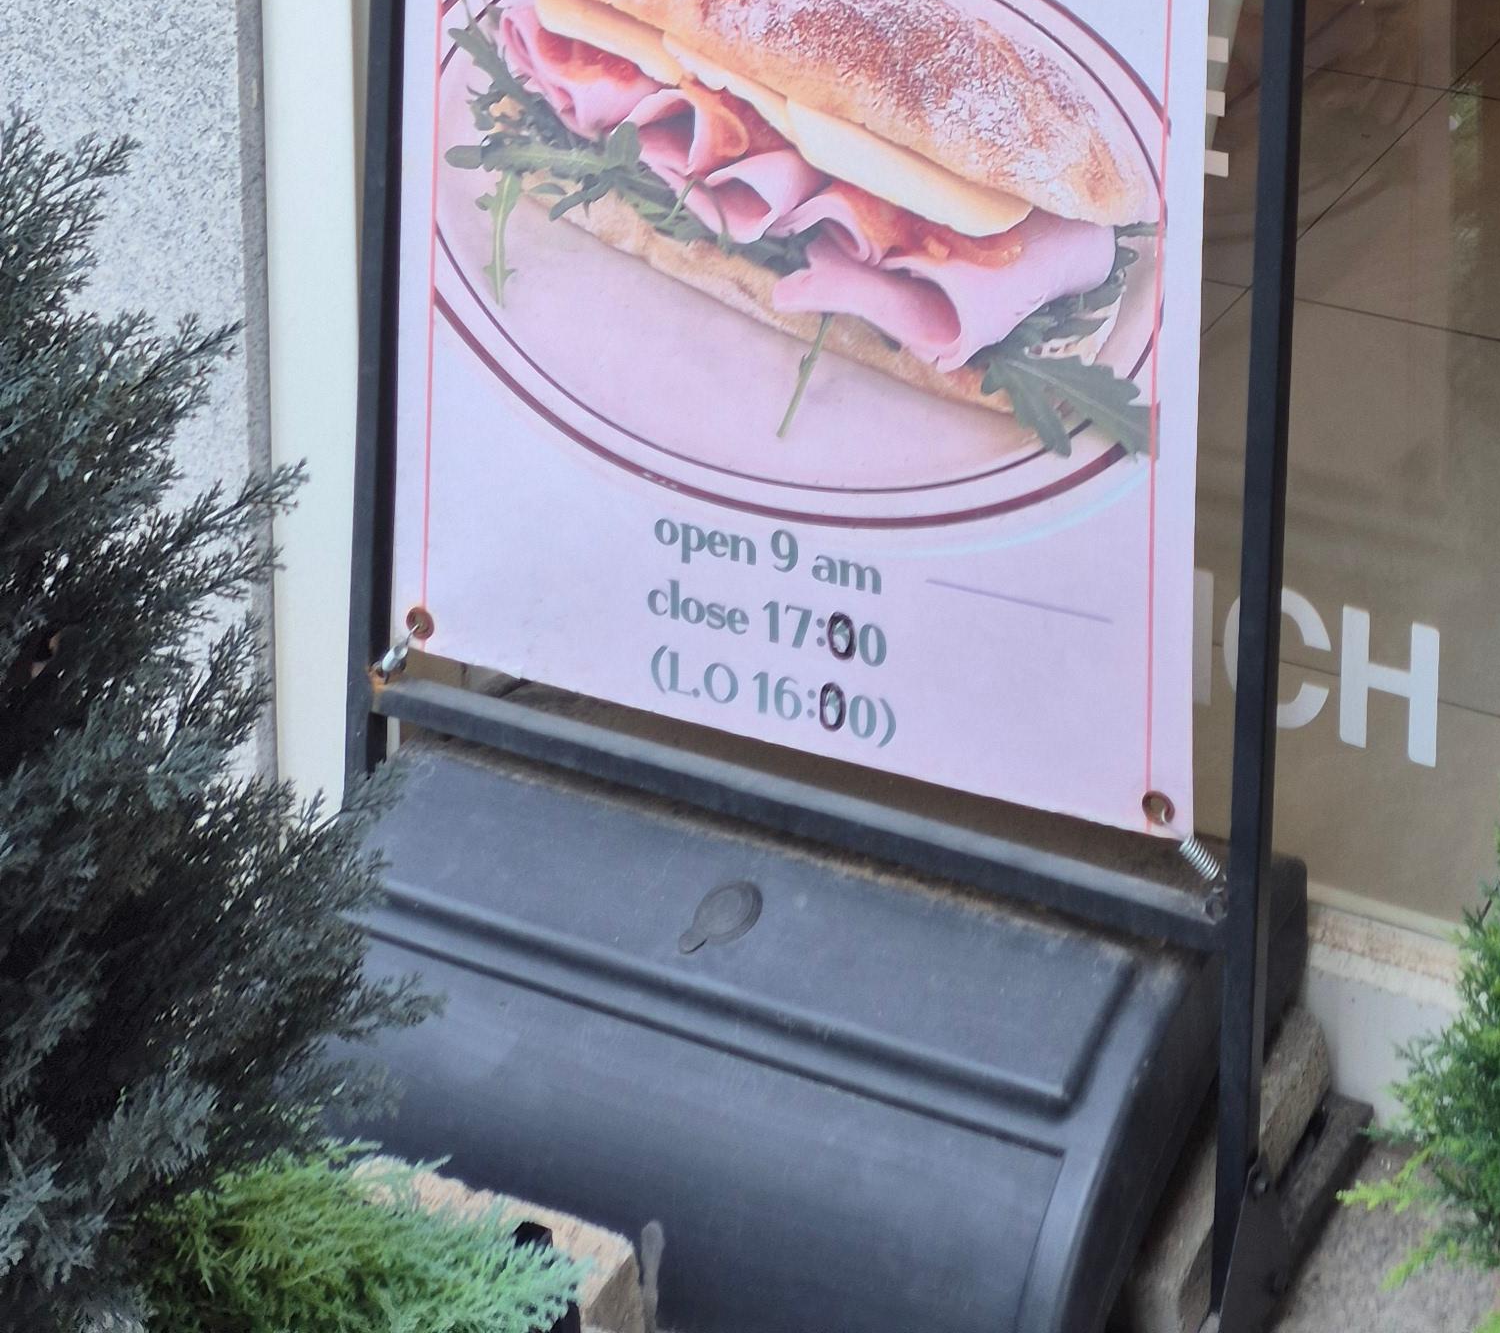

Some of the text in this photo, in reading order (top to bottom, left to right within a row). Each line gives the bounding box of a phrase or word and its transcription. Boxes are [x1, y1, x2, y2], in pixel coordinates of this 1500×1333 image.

[654, 517, 882, 595] open 9 am
[647, 579, 887, 667] close 17:00
